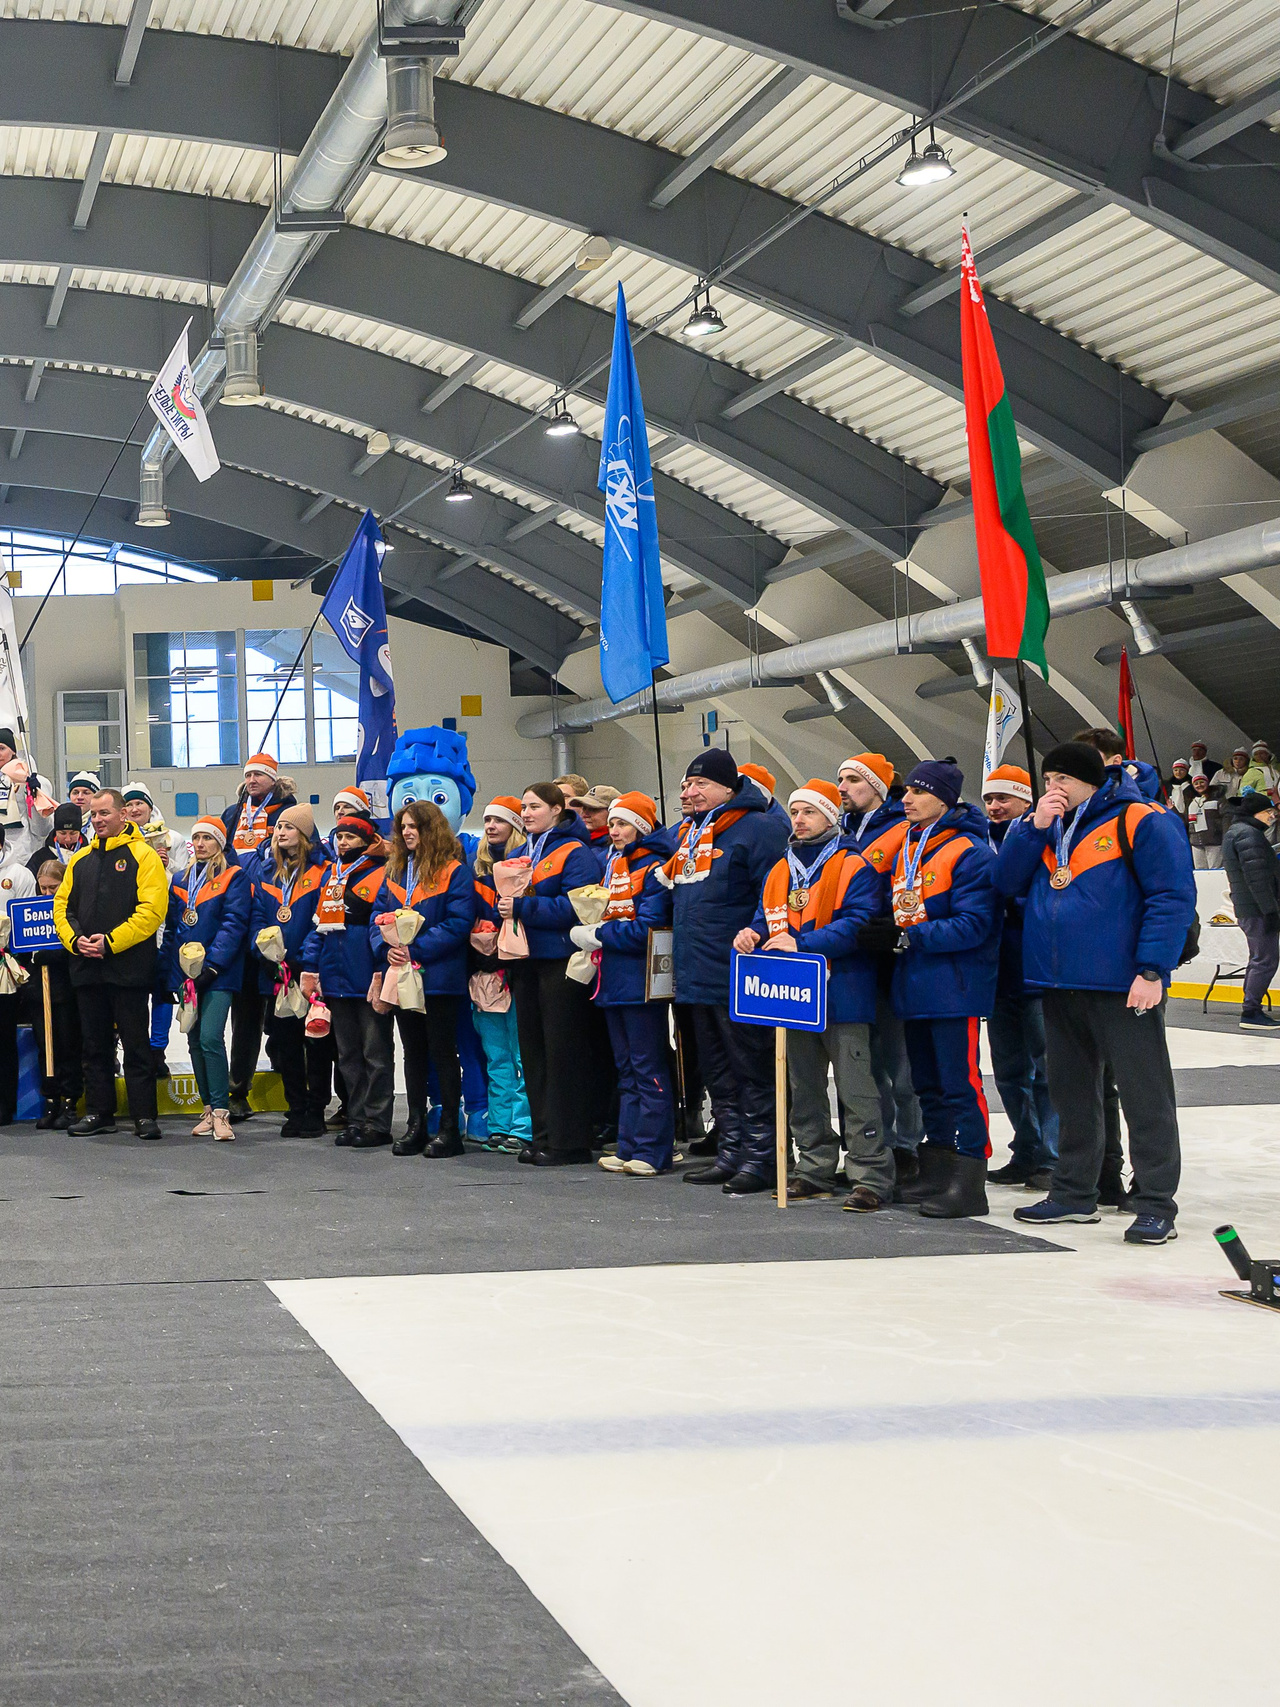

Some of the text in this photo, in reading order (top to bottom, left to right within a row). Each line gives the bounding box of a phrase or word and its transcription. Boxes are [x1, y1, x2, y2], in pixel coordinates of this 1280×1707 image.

[170, 410, 194, 441] ТИГРЫ
[23, 908, 54, 922] Белы
[744, 975, 812, 1003] Молния
